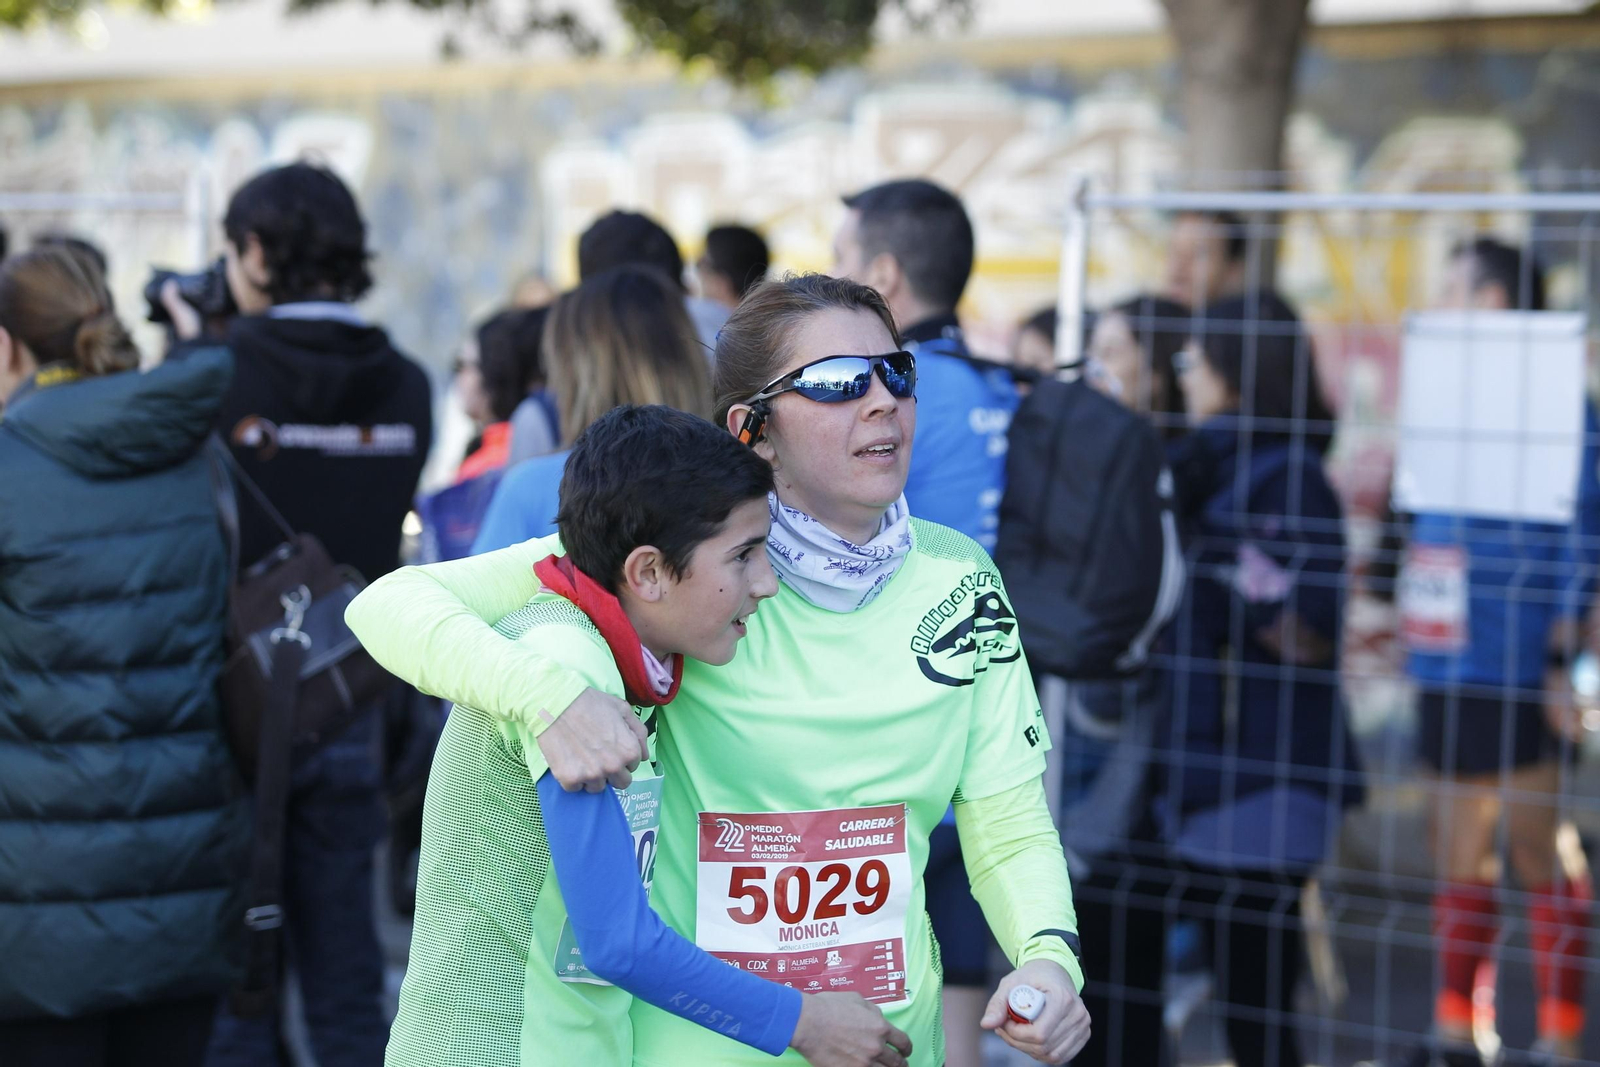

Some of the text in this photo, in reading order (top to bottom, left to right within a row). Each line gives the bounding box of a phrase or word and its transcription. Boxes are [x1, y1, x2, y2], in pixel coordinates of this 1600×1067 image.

[911, 572, 1001, 655] Alligatrs
[751, 825, 783, 834] MEDIO
[839, 816, 895, 833] CARRERA
[751, 833, 801, 843] MARATÓN
[825, 832, 895, 851] SALUDABLE
[751, 843, 796, 853] ALMERÍA
[726, 858, 892, 925] 5029
[779, 921, 840, 942] MÓNICA
[802, 942, 826, 950] ESTEBAN
[747, 959, 770, 970] CDX
[790, 956, 819, 967] ALMERÍA
[668, 990, 742, 1037] KIPSTA
